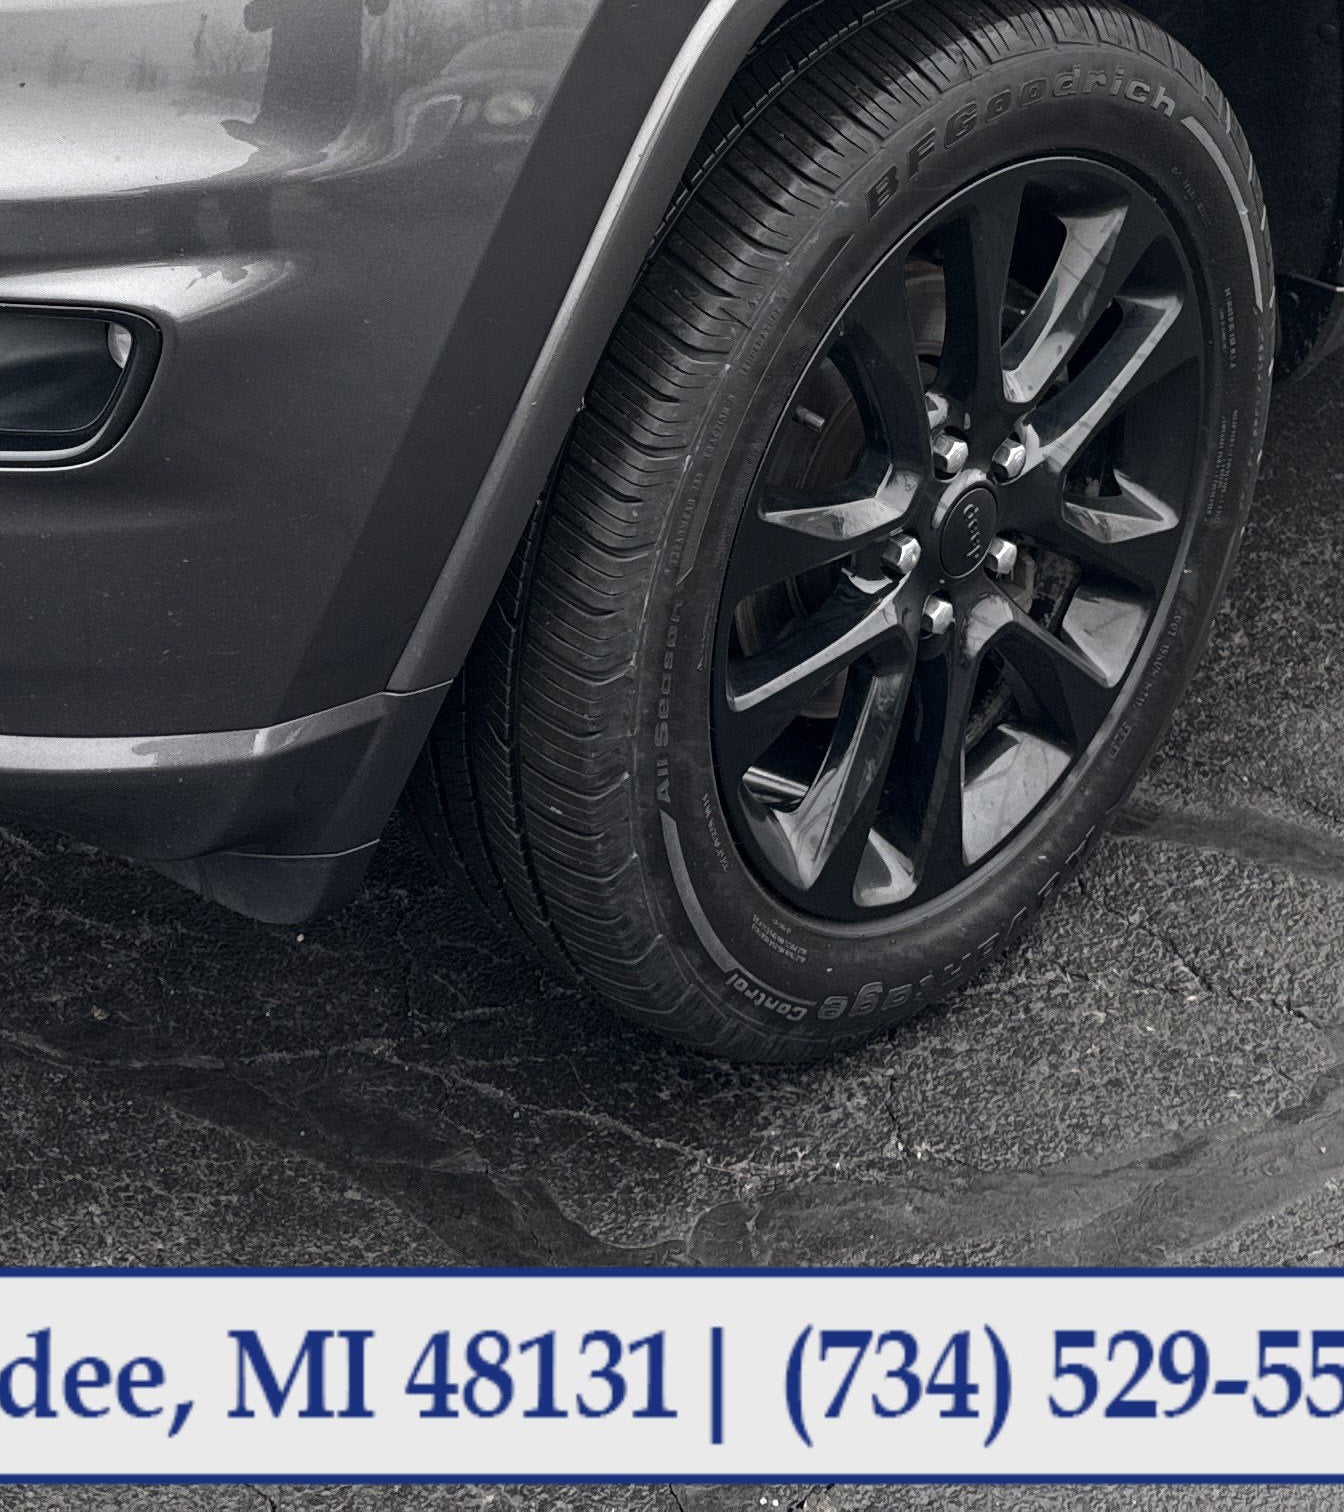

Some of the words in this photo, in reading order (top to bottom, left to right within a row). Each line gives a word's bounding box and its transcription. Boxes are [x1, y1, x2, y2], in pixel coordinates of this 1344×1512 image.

[654, 601, 685, 747] Season
[655, 758, 671, 804] All
[724, 973, 808, 1022] Control
